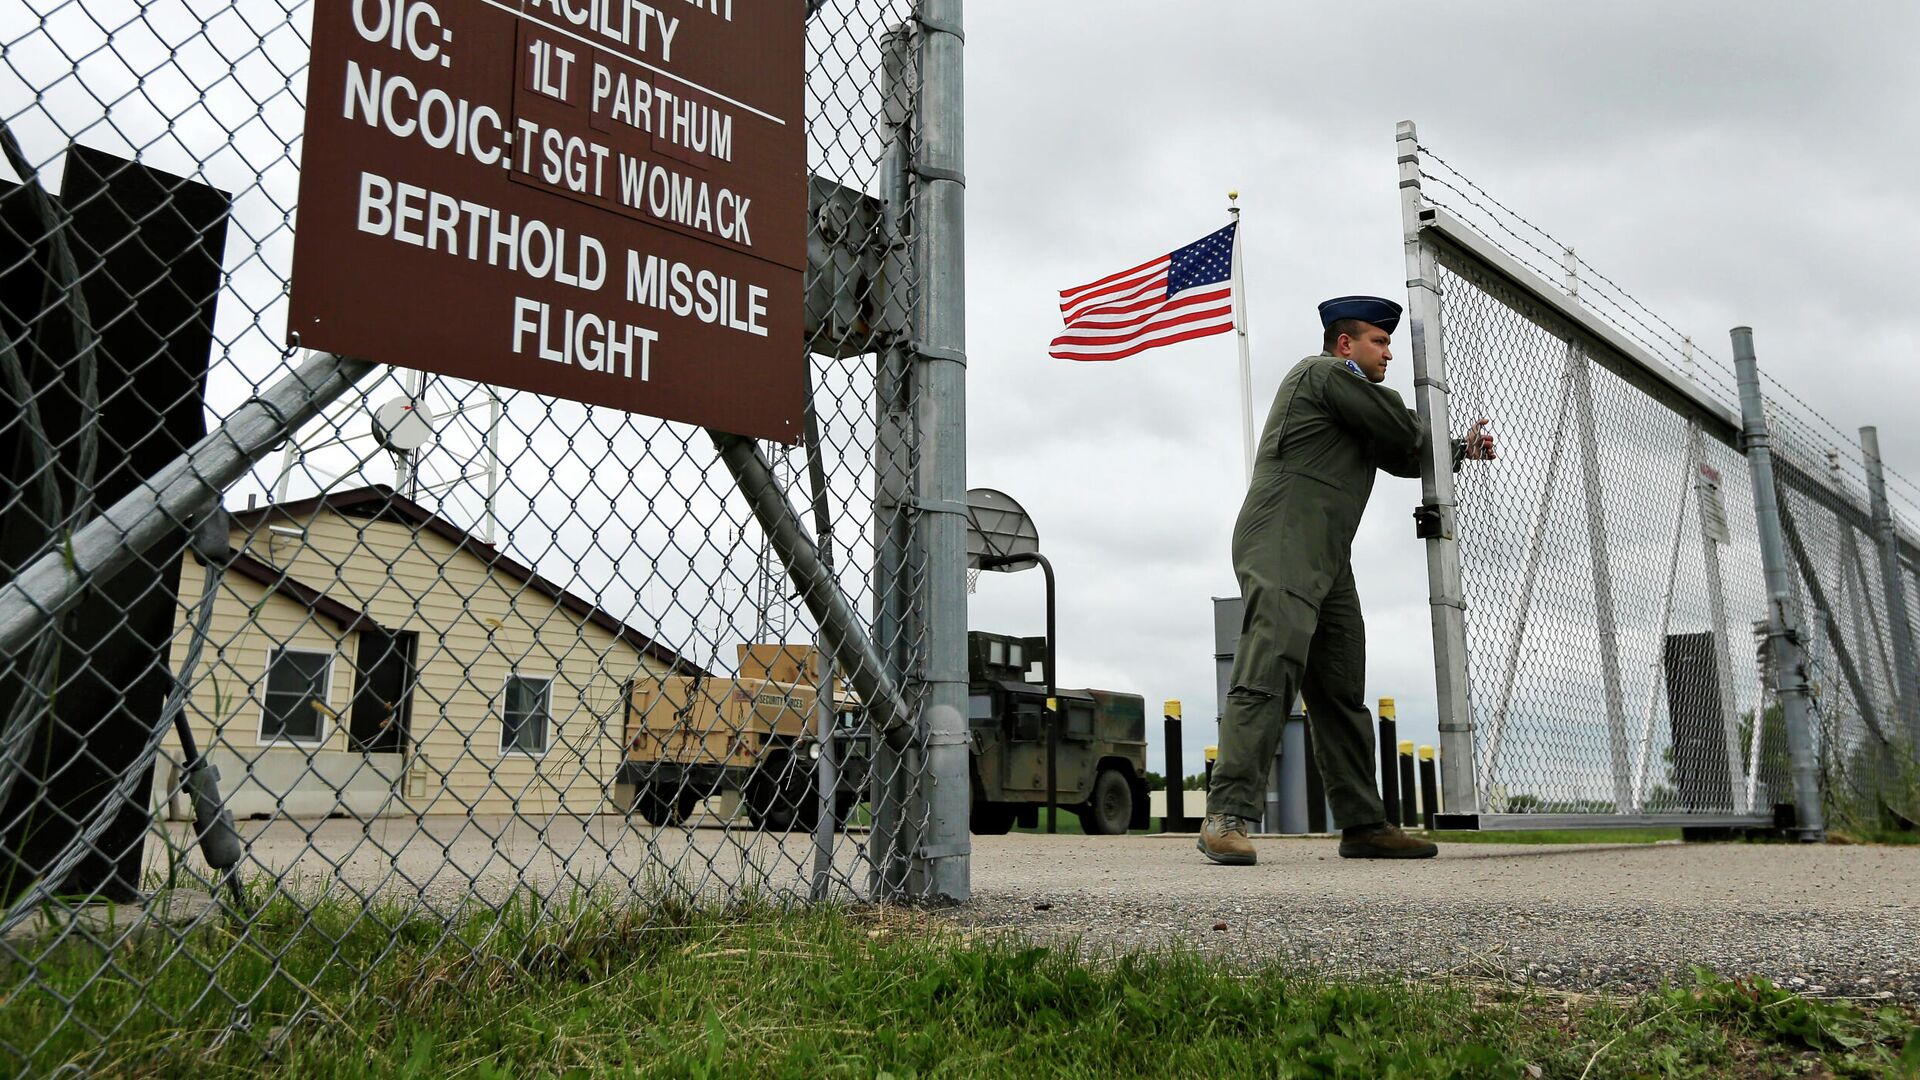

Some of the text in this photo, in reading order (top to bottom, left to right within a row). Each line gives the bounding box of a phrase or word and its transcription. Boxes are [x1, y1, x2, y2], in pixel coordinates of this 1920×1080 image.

[352, 0, 732, 162] OIC: 1LT PARTHUM
[522, 0, 680, 62] CILITY
[343, 60, 752, 246] NCOIC: TSGT WOMACK
[358, 171, 768, 337] BERTHOLD MISSILE
[513, 296, 659, 382] FLIGHT
